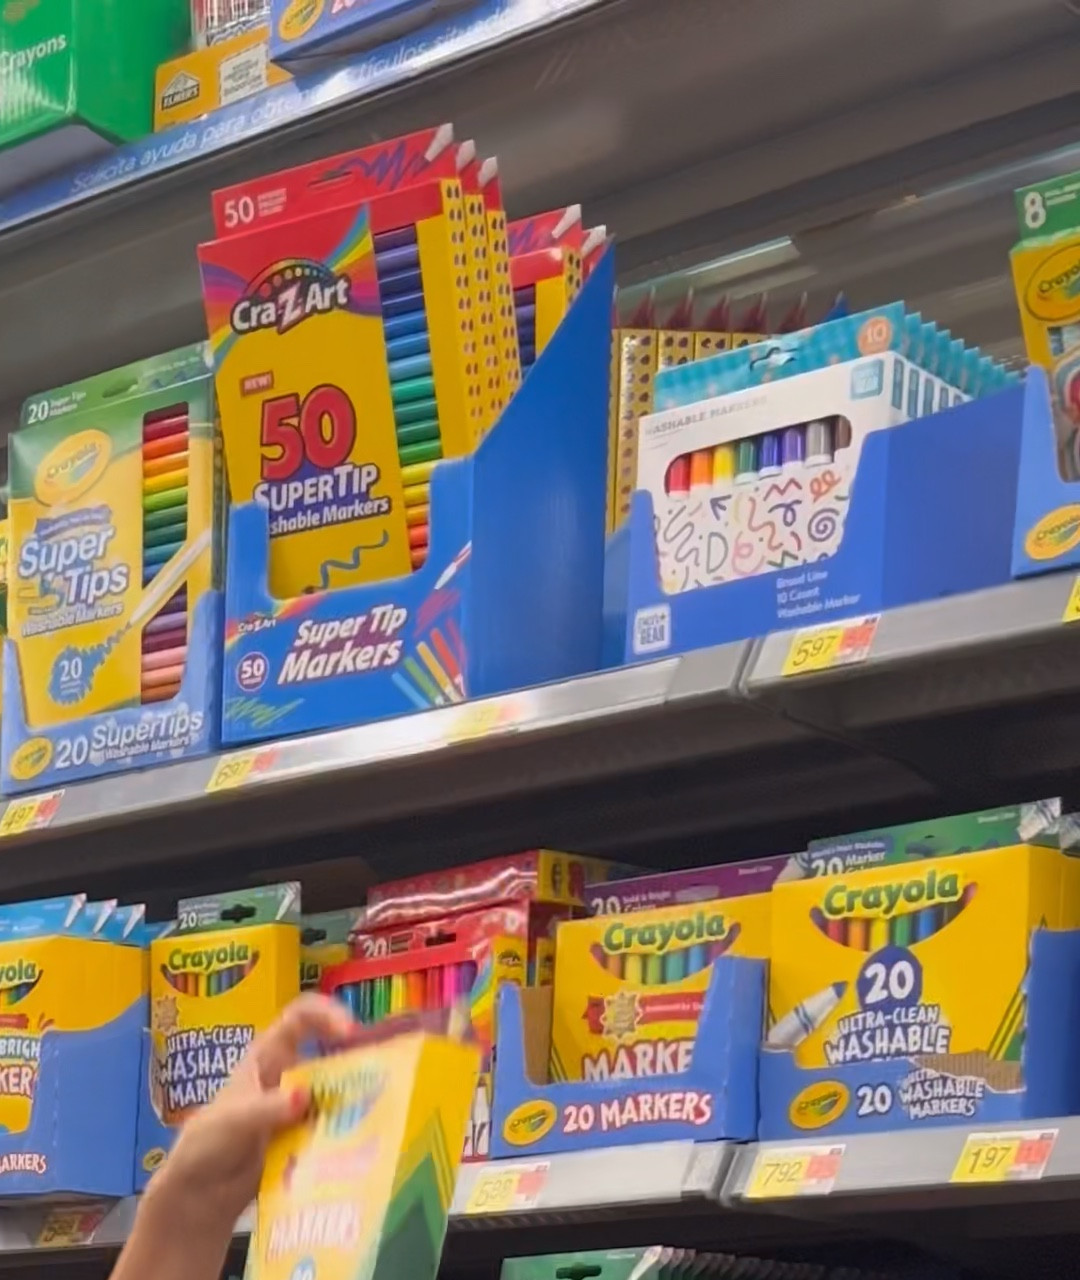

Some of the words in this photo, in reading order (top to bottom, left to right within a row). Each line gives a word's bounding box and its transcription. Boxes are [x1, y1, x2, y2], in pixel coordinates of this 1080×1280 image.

[139, 132, 197, 167] ayuda
[199, 115, 244, 150] para
[224, 196, 255, 229] 50
[1025, 191, 1047, 229] 8
[243, 374, 273, 394] NEW!
[27, 401, 50, 425] 20
[261, 383, 357, 480] 50
[322, 496, 390, 527] Markers
[19, 525, 117, 578] Super
[65, 563, 129, 604] Tips
[294, 611, 360, 650] Super
[370, 603, 408, 642] Tip
[59, 656, 83, 682] 20
[240, 655, 266, 681] 50
[278, 637, 403, 686] Markers
[56, 734, 88, 769] 20
[91, 709, 205, 750] SuperTips
[810, 858, 842, 877] 20
[846, 849, 886, 867] Marker
[592, 896, 619, 916] 20
[823, 870, 960, 918] Crayola
[179, 912, 198, 929] 20
[603, 911, 726, 955] Crayola
[168, 941, 250, 972] Crayola
[363, 937, 388, 958] 20
[864, 961, 915, 1003] 20
[838, 1003, 940, 1038] ULTRA-CLEAN
[166, 1027, 254, 1054] ULTRA-CLEAN
[824, 1026, 951, 1065] WASHABLE
[160, 1045, 246, 1086] WASHAB
[583, 1040, 693, 1083] MARKE
[563, 1105, 595, 1133] 20
[600, 1092, 713, 1133] MARKERS
[856, 1084, 892, 1117] 20
[899, 1079, 986, 1107] WASHABLE
[909, 1099, 976, 1119] MARKERS
[968, 1146, 1012, 1174] 197
